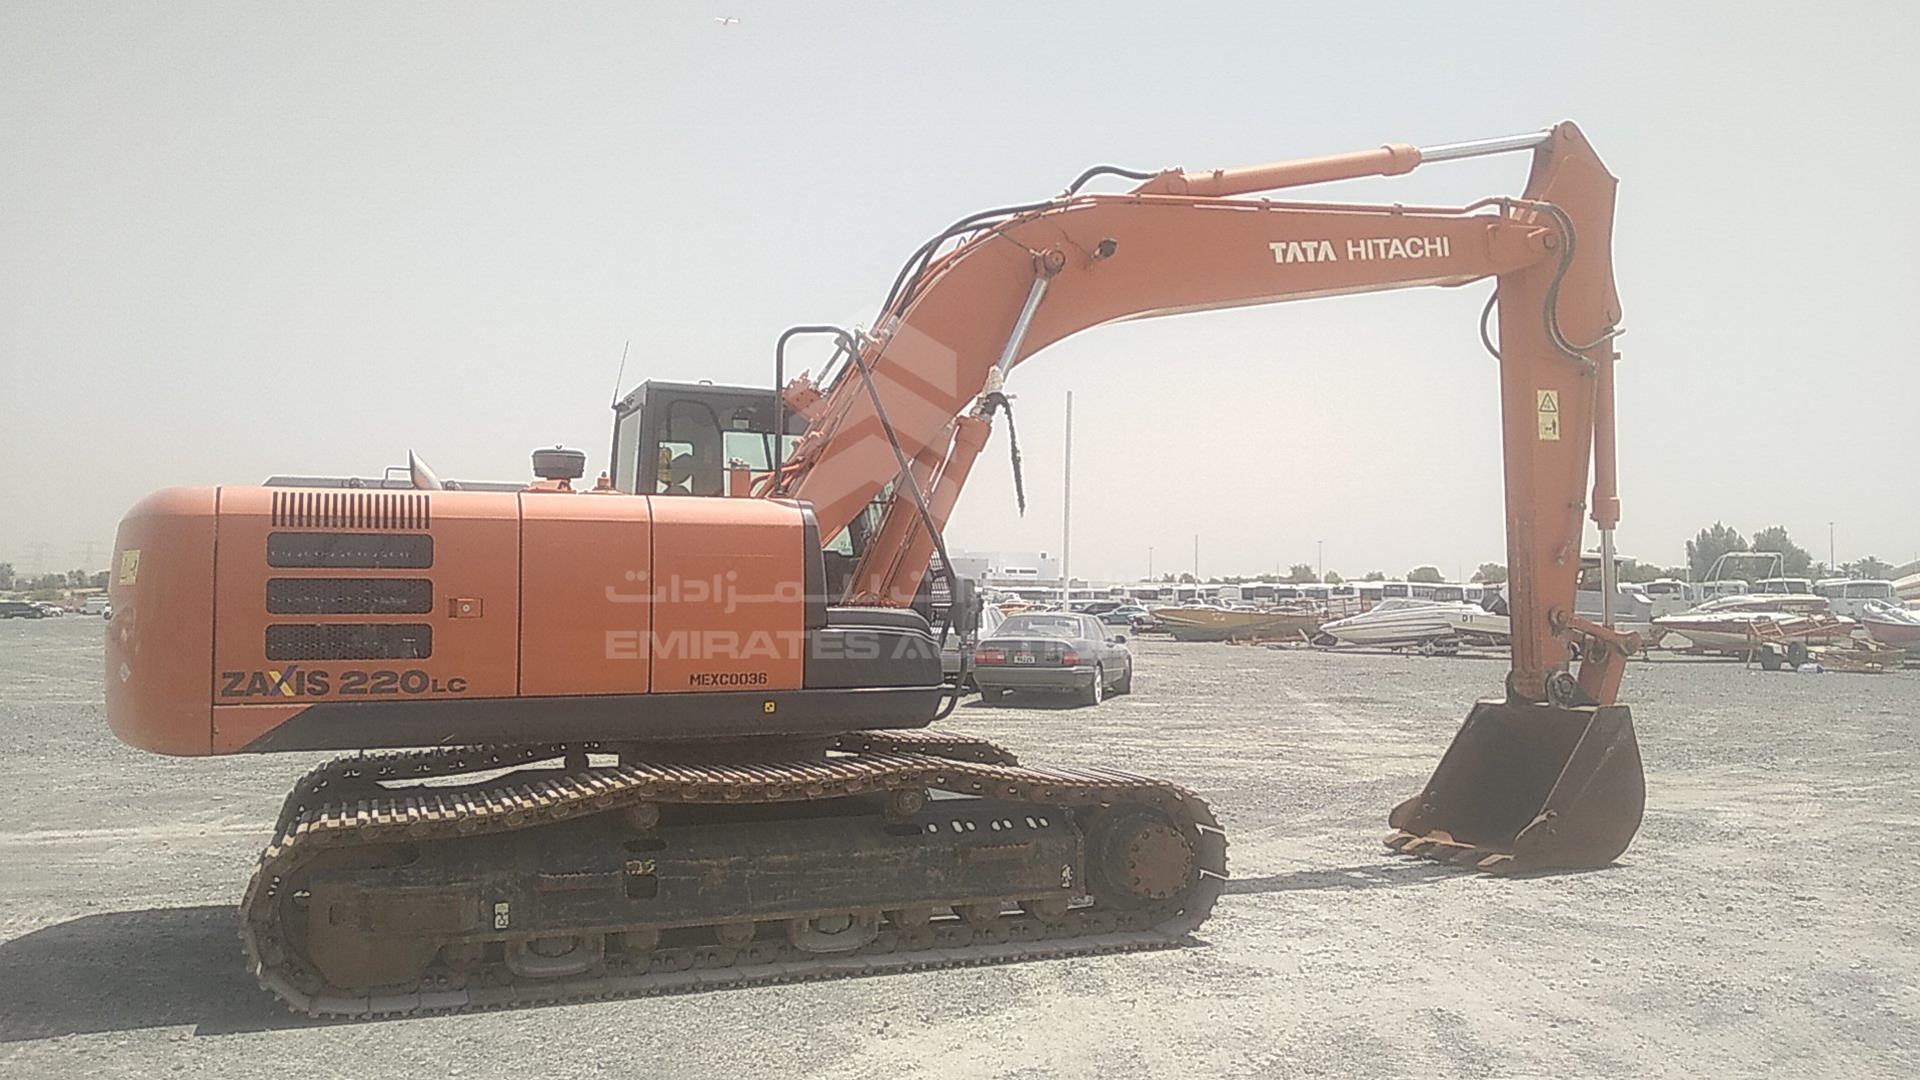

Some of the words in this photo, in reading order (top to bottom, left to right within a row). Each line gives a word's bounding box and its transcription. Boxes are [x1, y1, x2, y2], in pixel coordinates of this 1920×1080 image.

[1269, 240, 1337, 263] TATA
[1346, 236, 1450, 261] HITACHI
[221, 664, 331, 697] ZAXIS
[689, 672, 768, 686] MEXC0036
